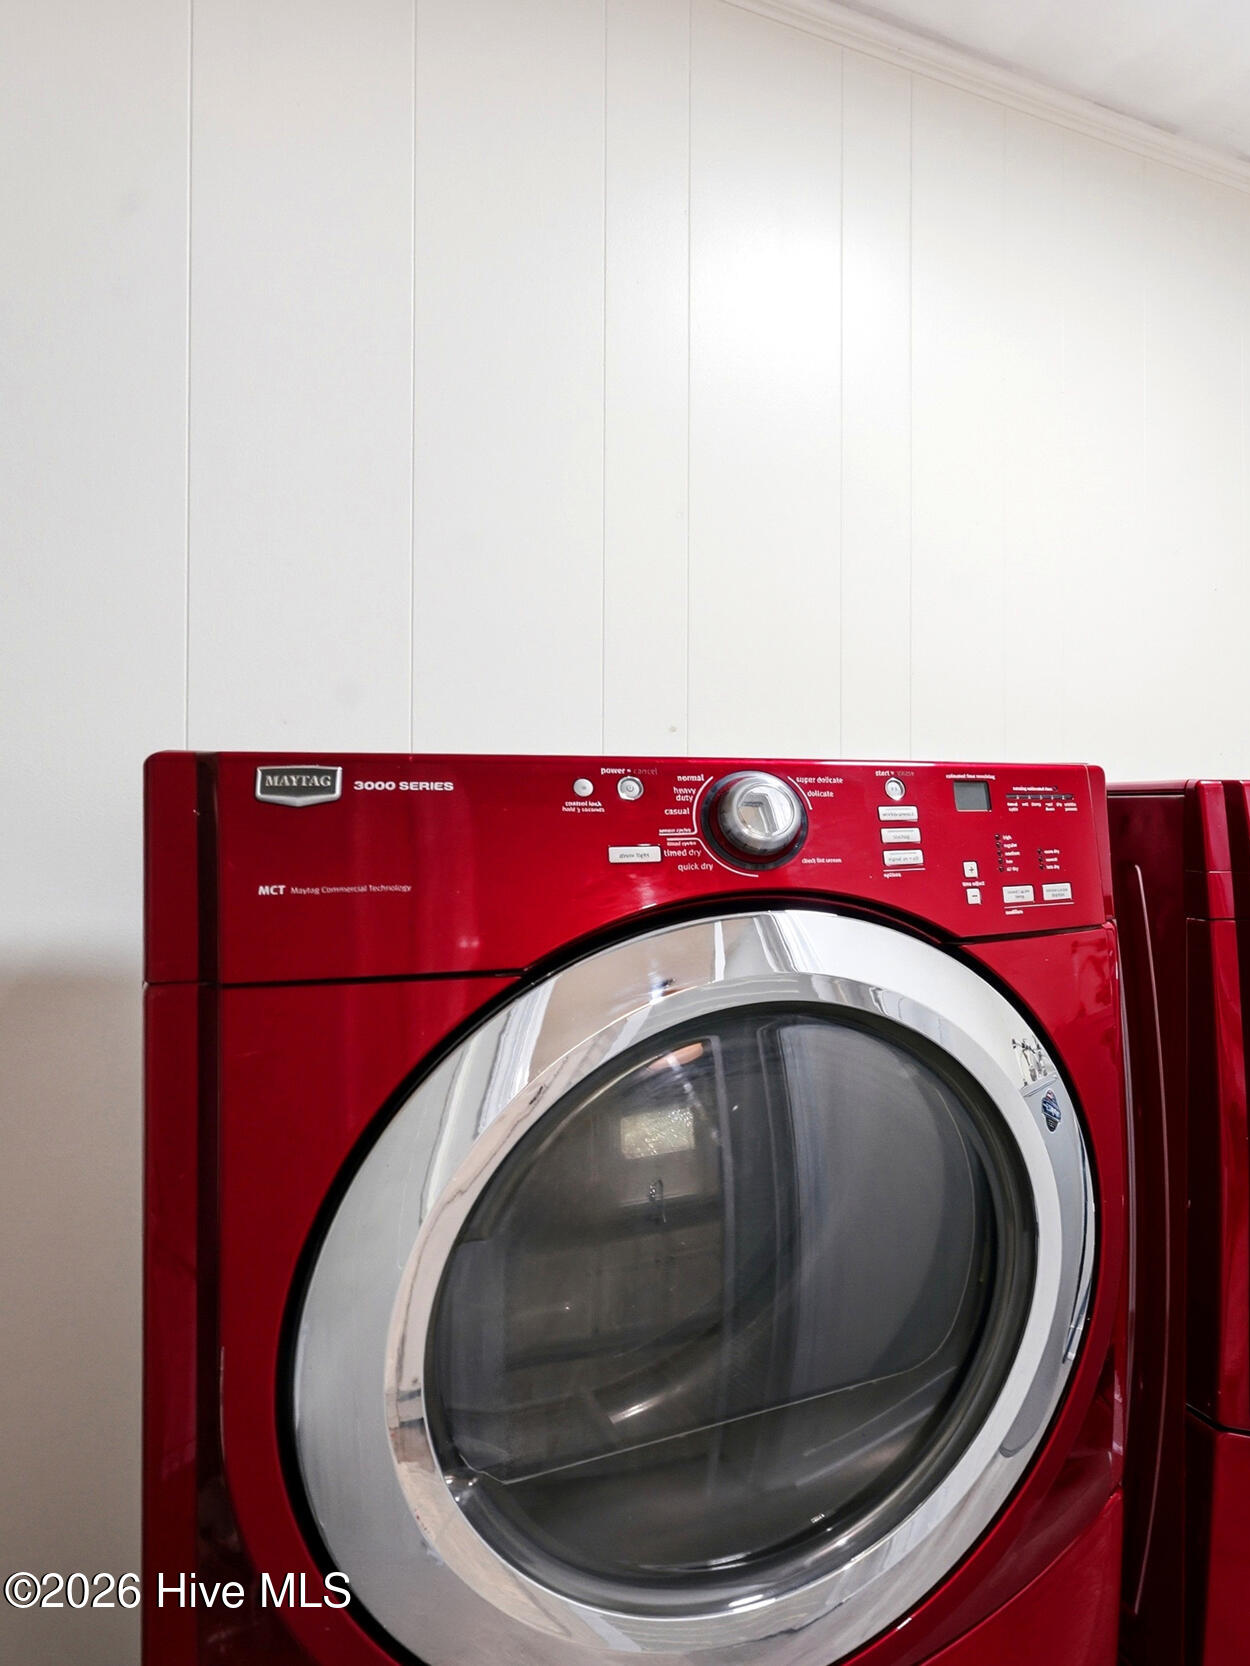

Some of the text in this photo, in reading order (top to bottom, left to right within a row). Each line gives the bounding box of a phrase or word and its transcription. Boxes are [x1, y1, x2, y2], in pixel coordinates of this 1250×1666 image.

[600, 767, 626, 775] power
[265, 774, 332, 787] MAYTAG
[677, 774, 705, 782] normal
[816, 776, 843, 784] delicate
[353, 781, 454, 791] 3000 SERIES
[673, 786, 697, 796] heavy
[807, 790, 834, 798] delicate
[676, 794, 694, 803] duty
[663, 849, 701, 857] timed dry
[677, 862, 713, 872] quick dry
[258, 884, 412, 895] MCT Maytag Commercial Technology
